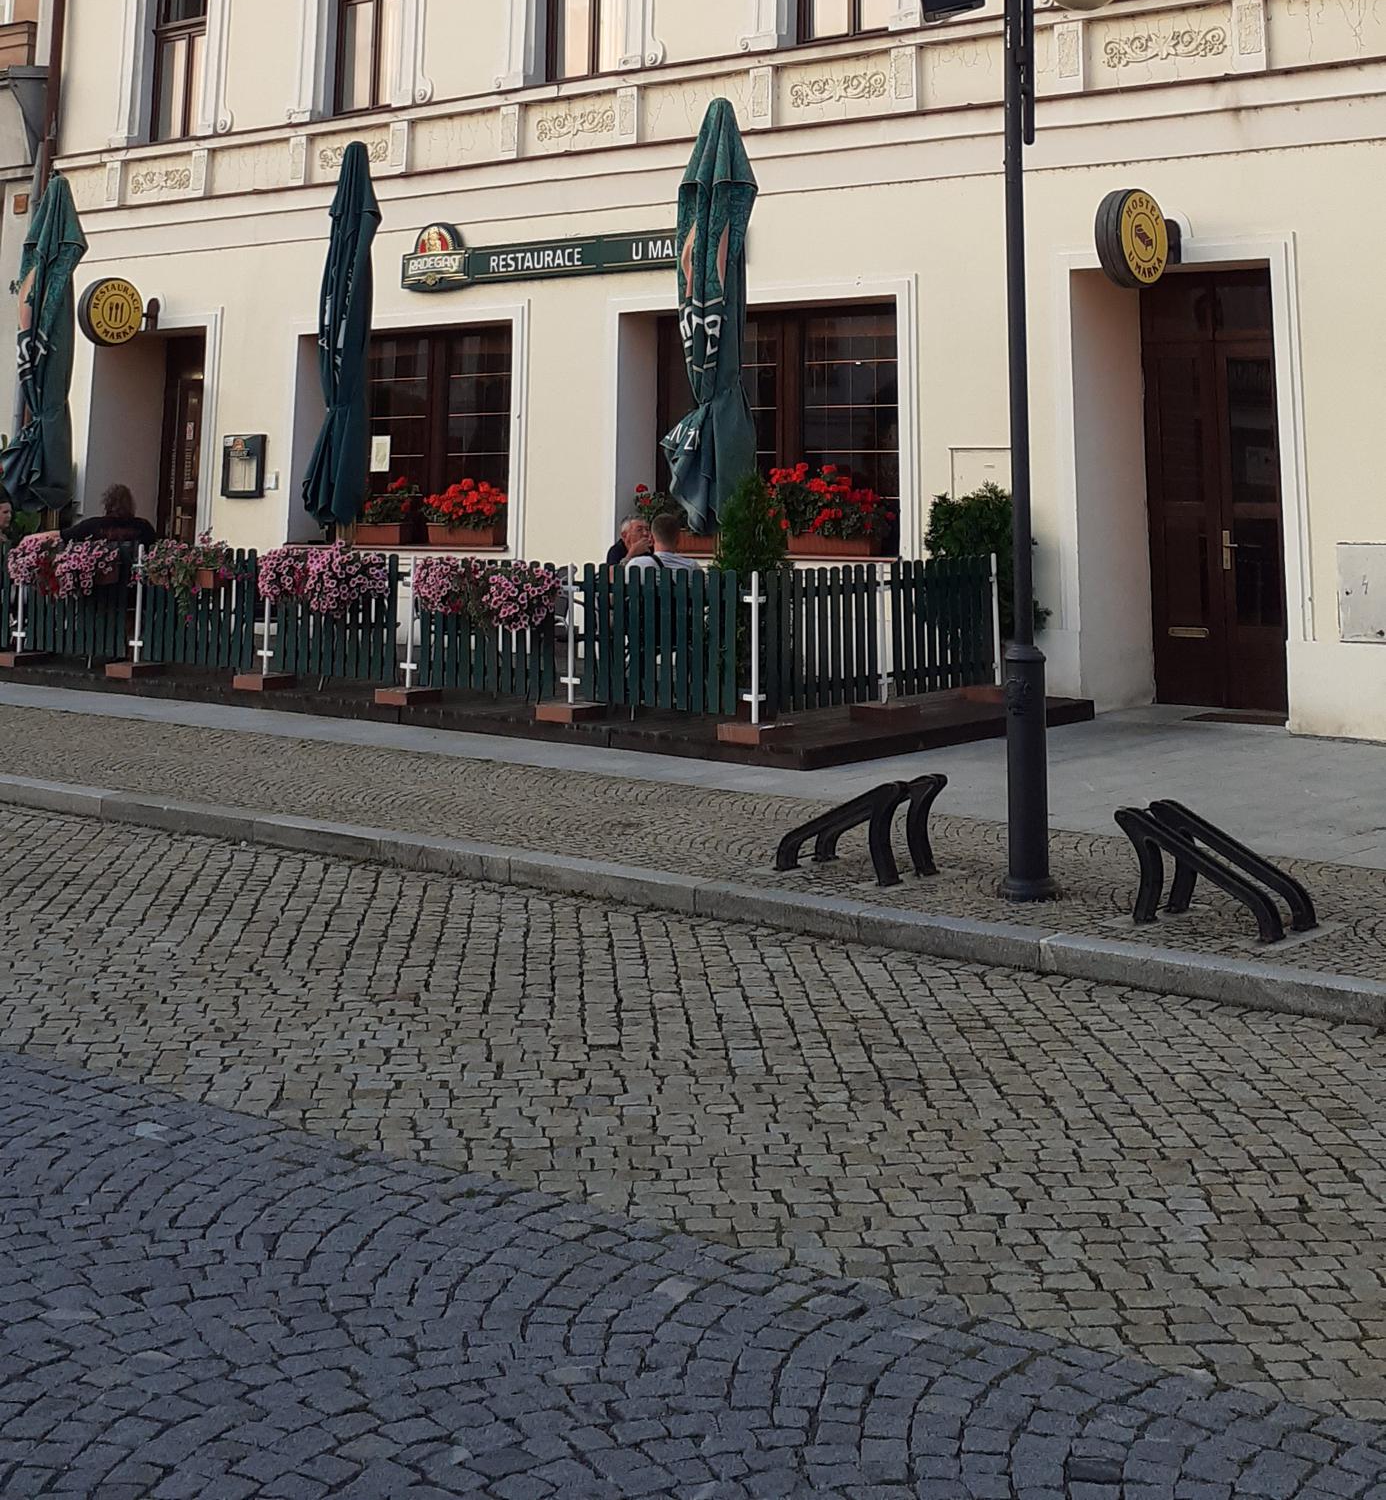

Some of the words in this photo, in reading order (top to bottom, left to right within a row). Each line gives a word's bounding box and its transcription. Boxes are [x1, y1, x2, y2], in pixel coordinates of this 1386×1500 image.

[1125, 197, 1162, 226] HOSTEL
[408, 255, 461, 274] RADEGAST
[489, 247, 583, 273] RESTAURACE
[632, 241, 643, 261] U
[1134, 257, 1163, 278] MARKA
[93, 283, 140, 313] RESTAURACE
[102, 324, 135, 340] MARKA
